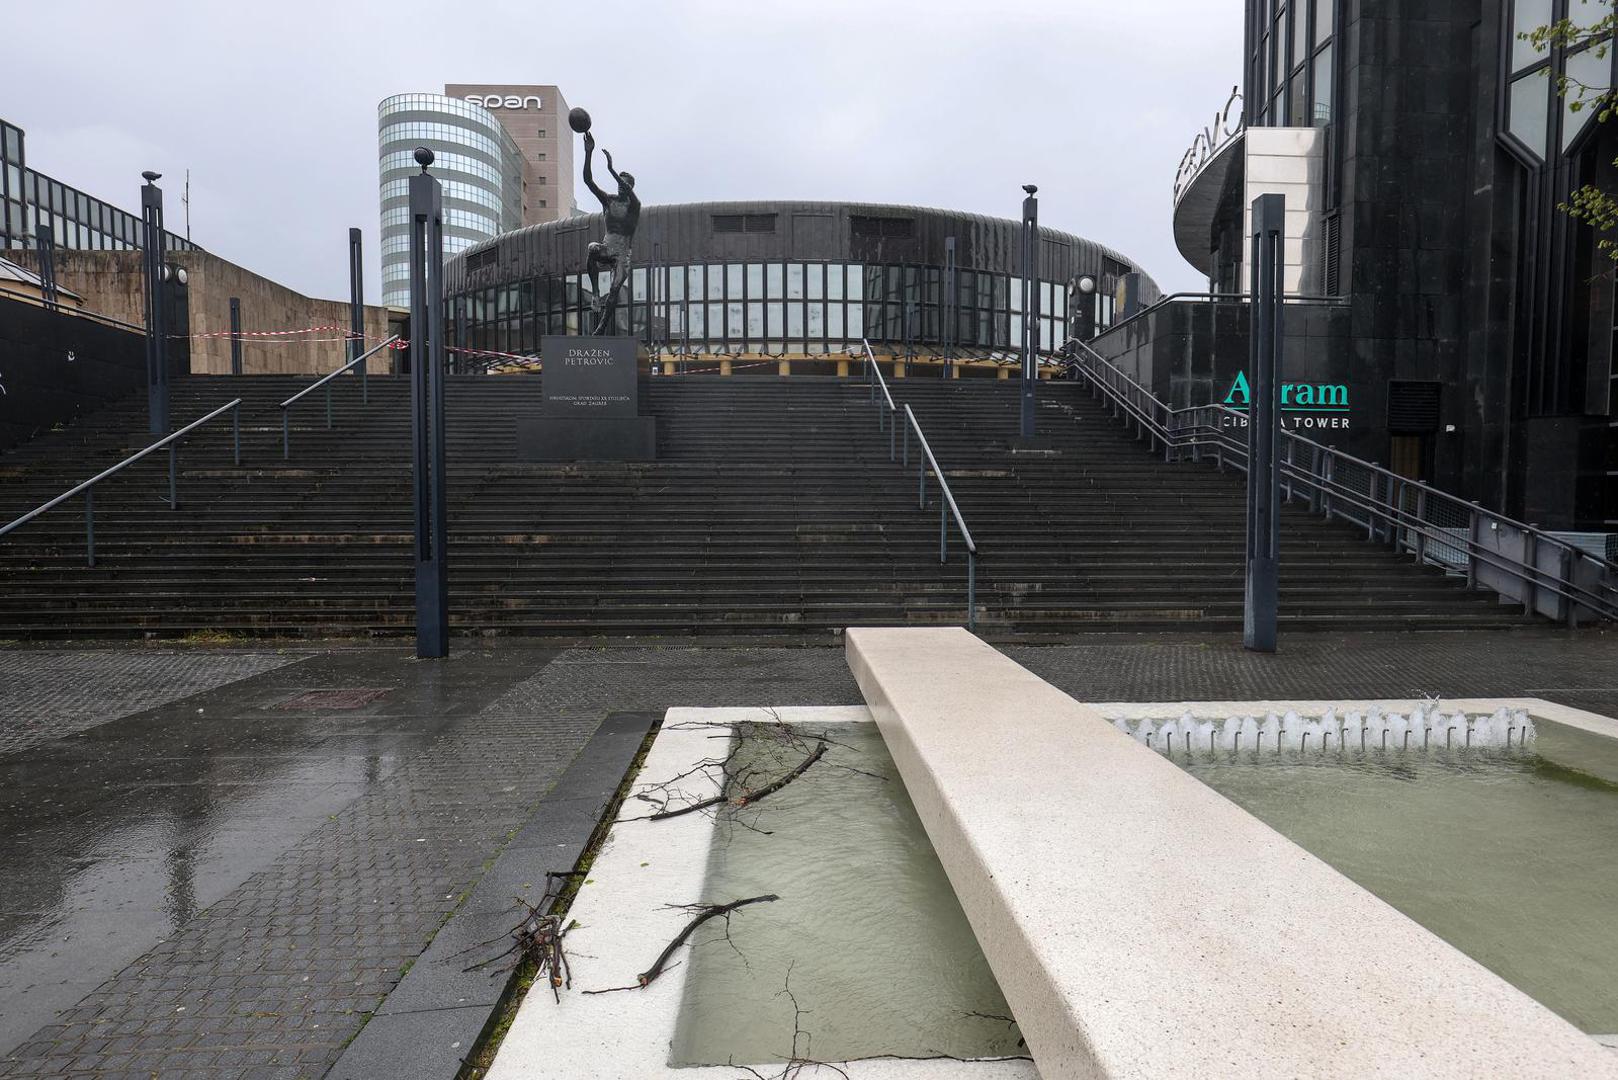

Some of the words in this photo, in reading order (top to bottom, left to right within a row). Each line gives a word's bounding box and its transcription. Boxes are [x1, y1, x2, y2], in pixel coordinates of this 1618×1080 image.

[464, 94, 542, 109] span
[569, 348, 610, 357] DRAŽEN
[1223, 370, 1350, 405] Aram
[1223, 416, 1286, 428] CIBA
[1293, 417, 1351, 429] TOWER
